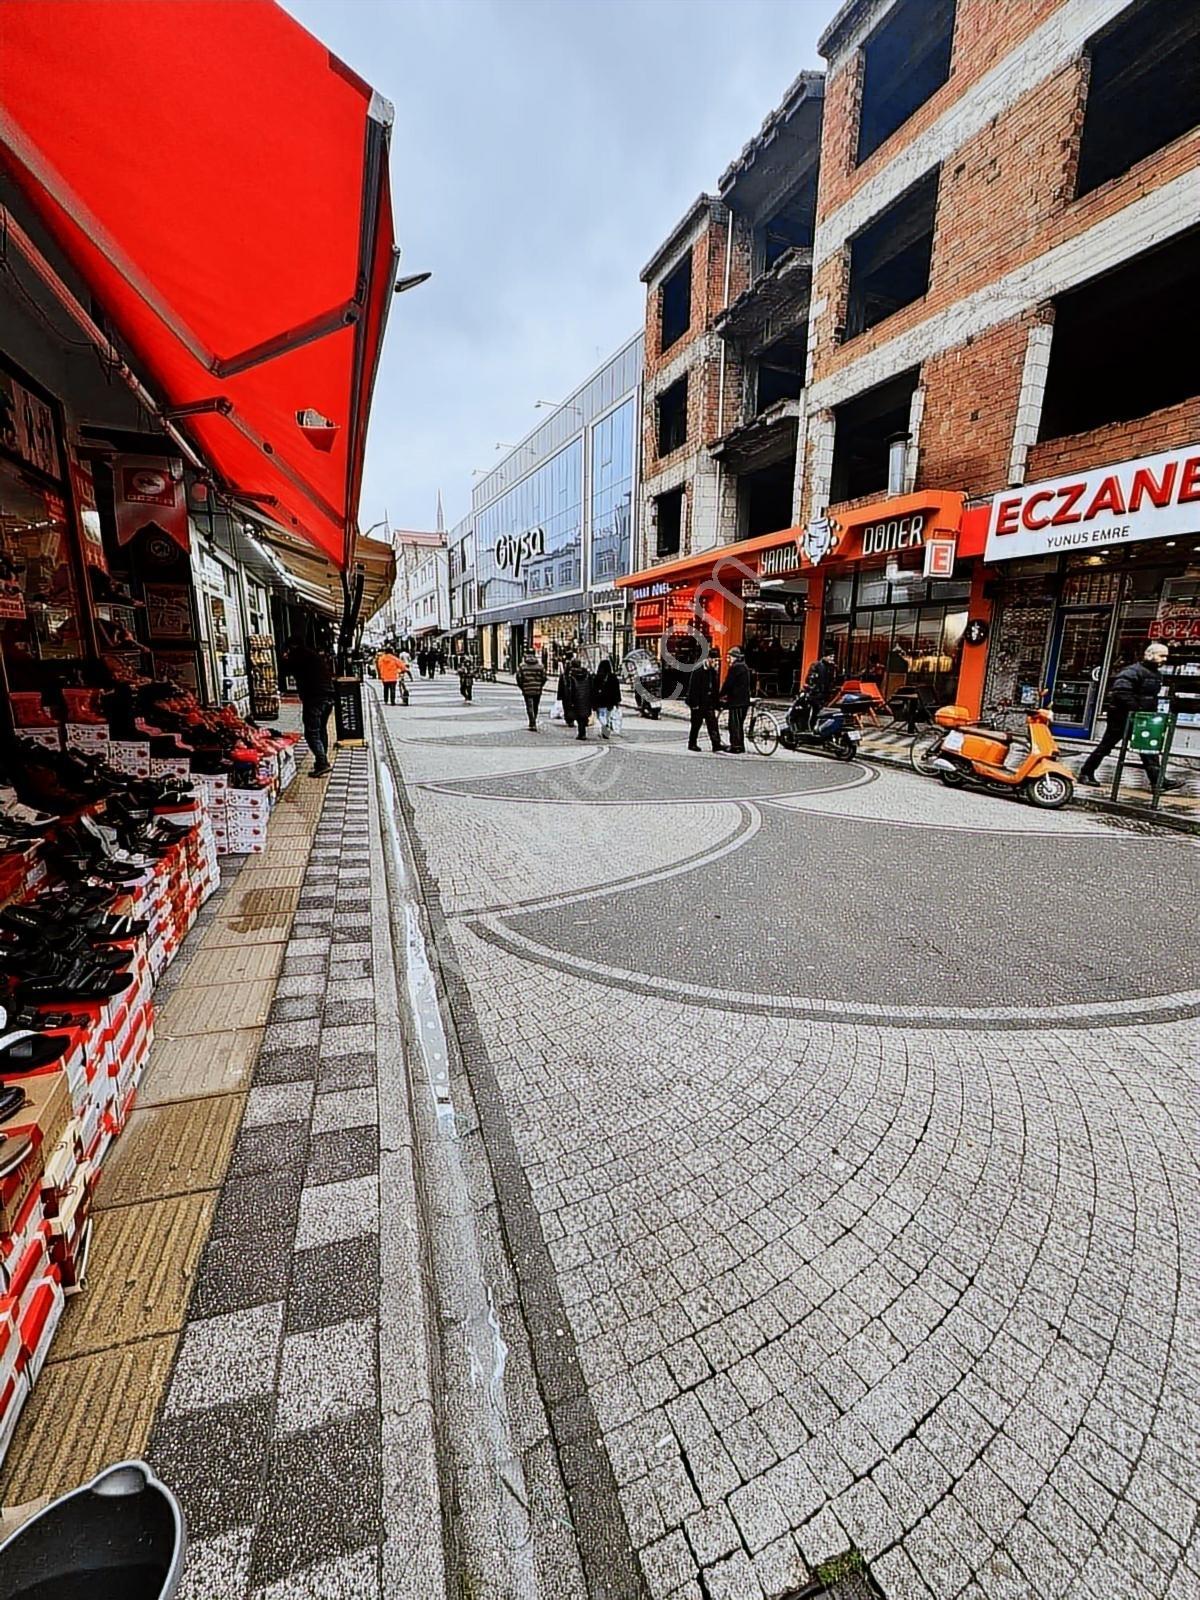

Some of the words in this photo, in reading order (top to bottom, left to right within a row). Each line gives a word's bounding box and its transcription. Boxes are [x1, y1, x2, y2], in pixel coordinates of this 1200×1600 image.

[996, 456, 1200, 536] ECZANE
[496, 527, 545, 578] Giysa
[862, 515, 924, 555] DÖNER
[1047, 532, 1088, 548] YUNUS
[1092, 525, 1131, 541] EMRE
[933, 547, 951, 572] E
